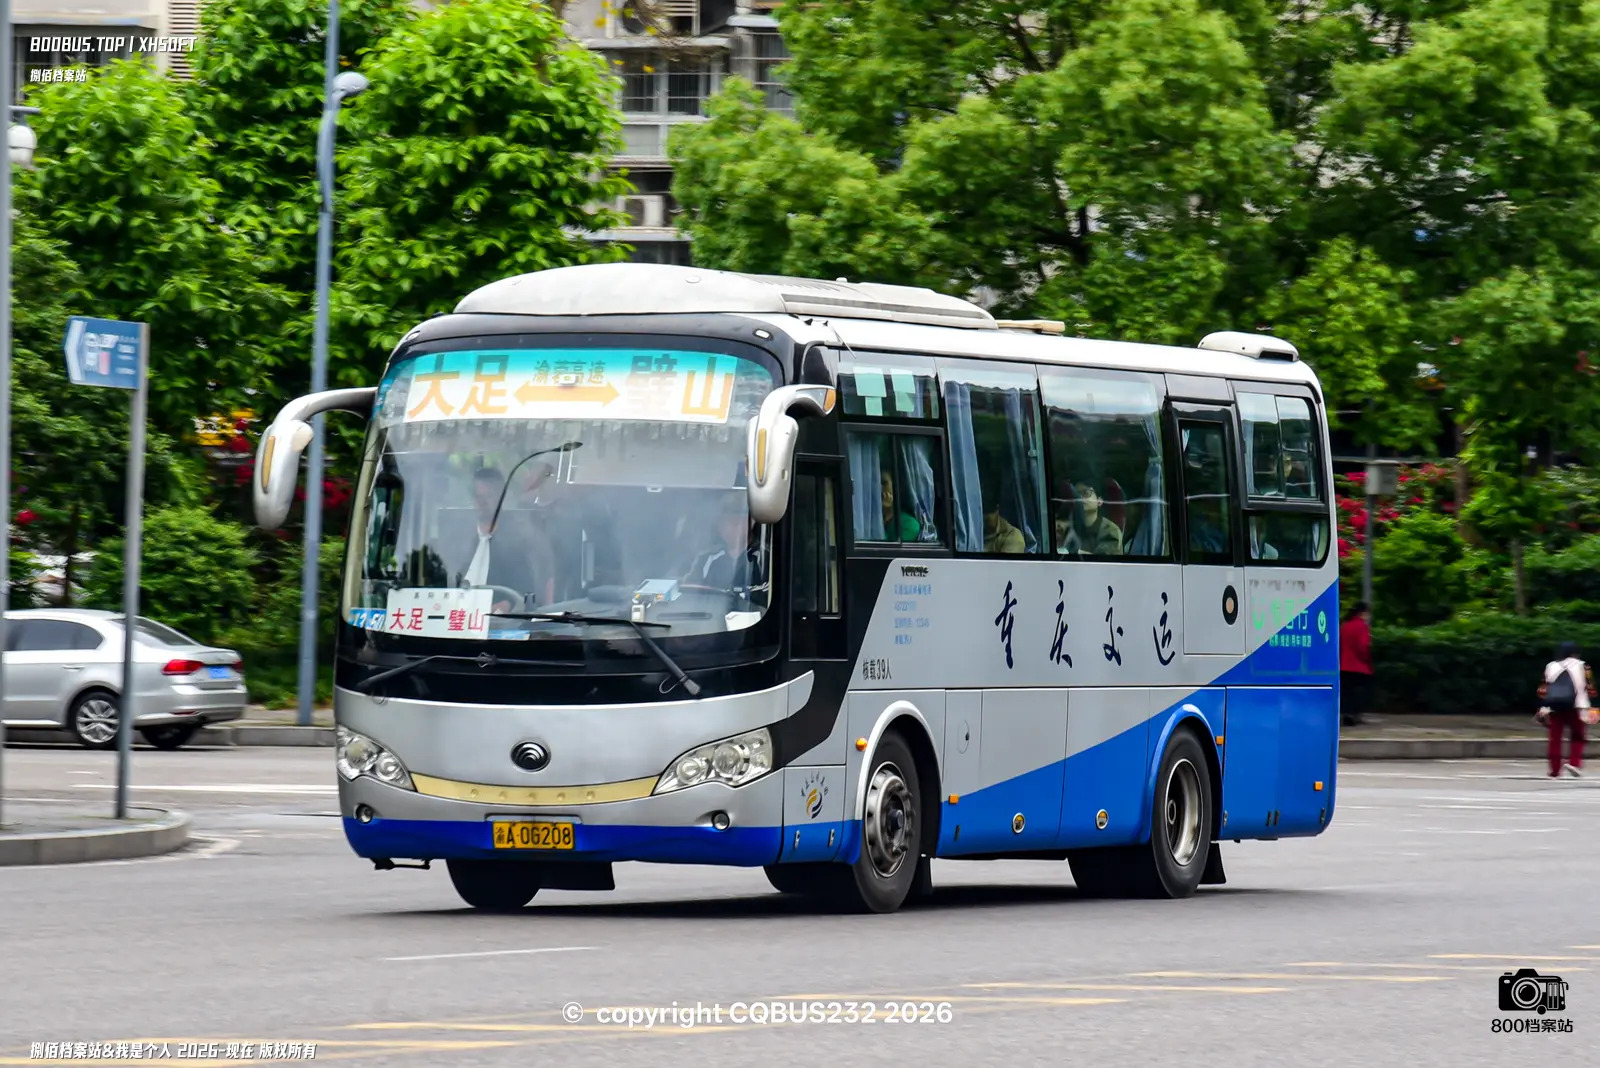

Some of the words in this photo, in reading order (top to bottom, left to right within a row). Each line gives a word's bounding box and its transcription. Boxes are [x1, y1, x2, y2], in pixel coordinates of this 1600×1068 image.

[407, 353, 510, 418] 大足
[994, 579, 1176, 670] 重庆交运
[862, 658, 892, 680] 核载39人
